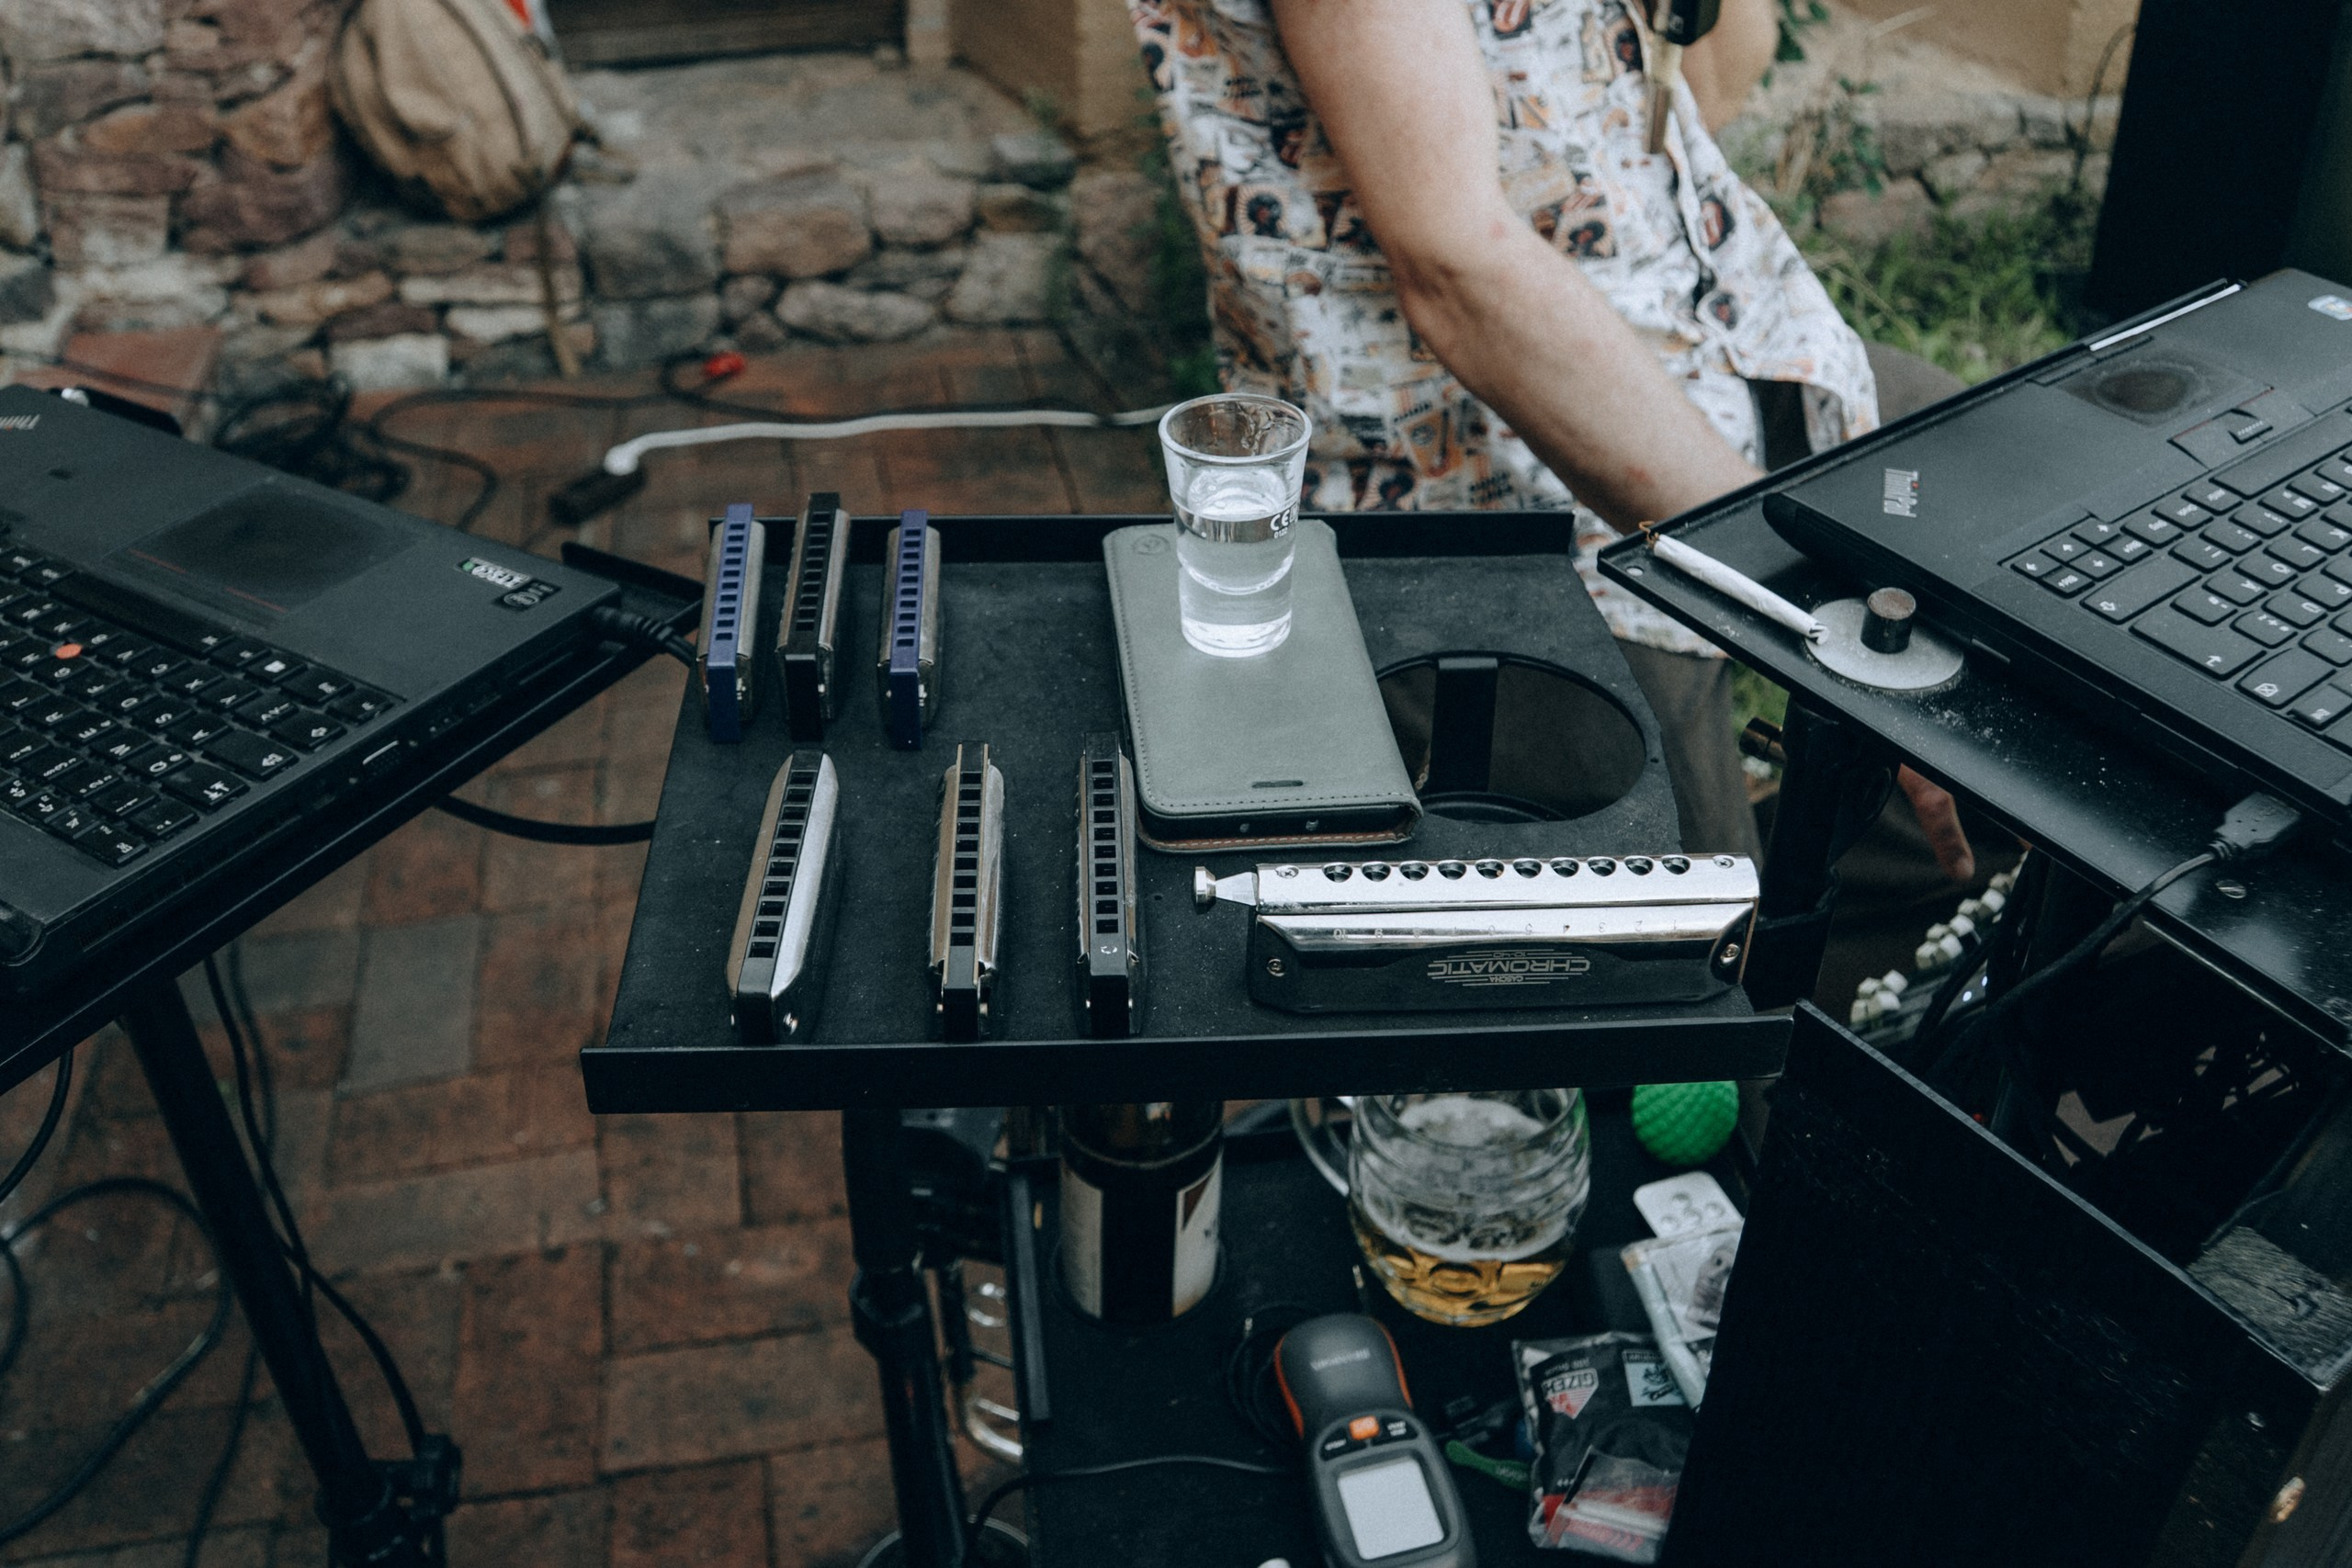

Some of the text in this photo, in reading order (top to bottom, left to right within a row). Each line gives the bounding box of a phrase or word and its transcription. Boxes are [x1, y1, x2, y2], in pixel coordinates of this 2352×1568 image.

[2329, 528, 2349, 540] K
[2301, 545, 2321, 555] L
[2334, 583, 2352, 595] P
[185, 678, 205, 691] X
[11, 696, 28, 707] T
[220, 694, 237, 705] Y
[154, 713, 173, 725] S
[191, 728, 209, 740] A
[108, 743, 131, 757] W
[1427, 958, 1590, 976] CHROMATIC
[1487, 975, 1525, 984] CASCHA
